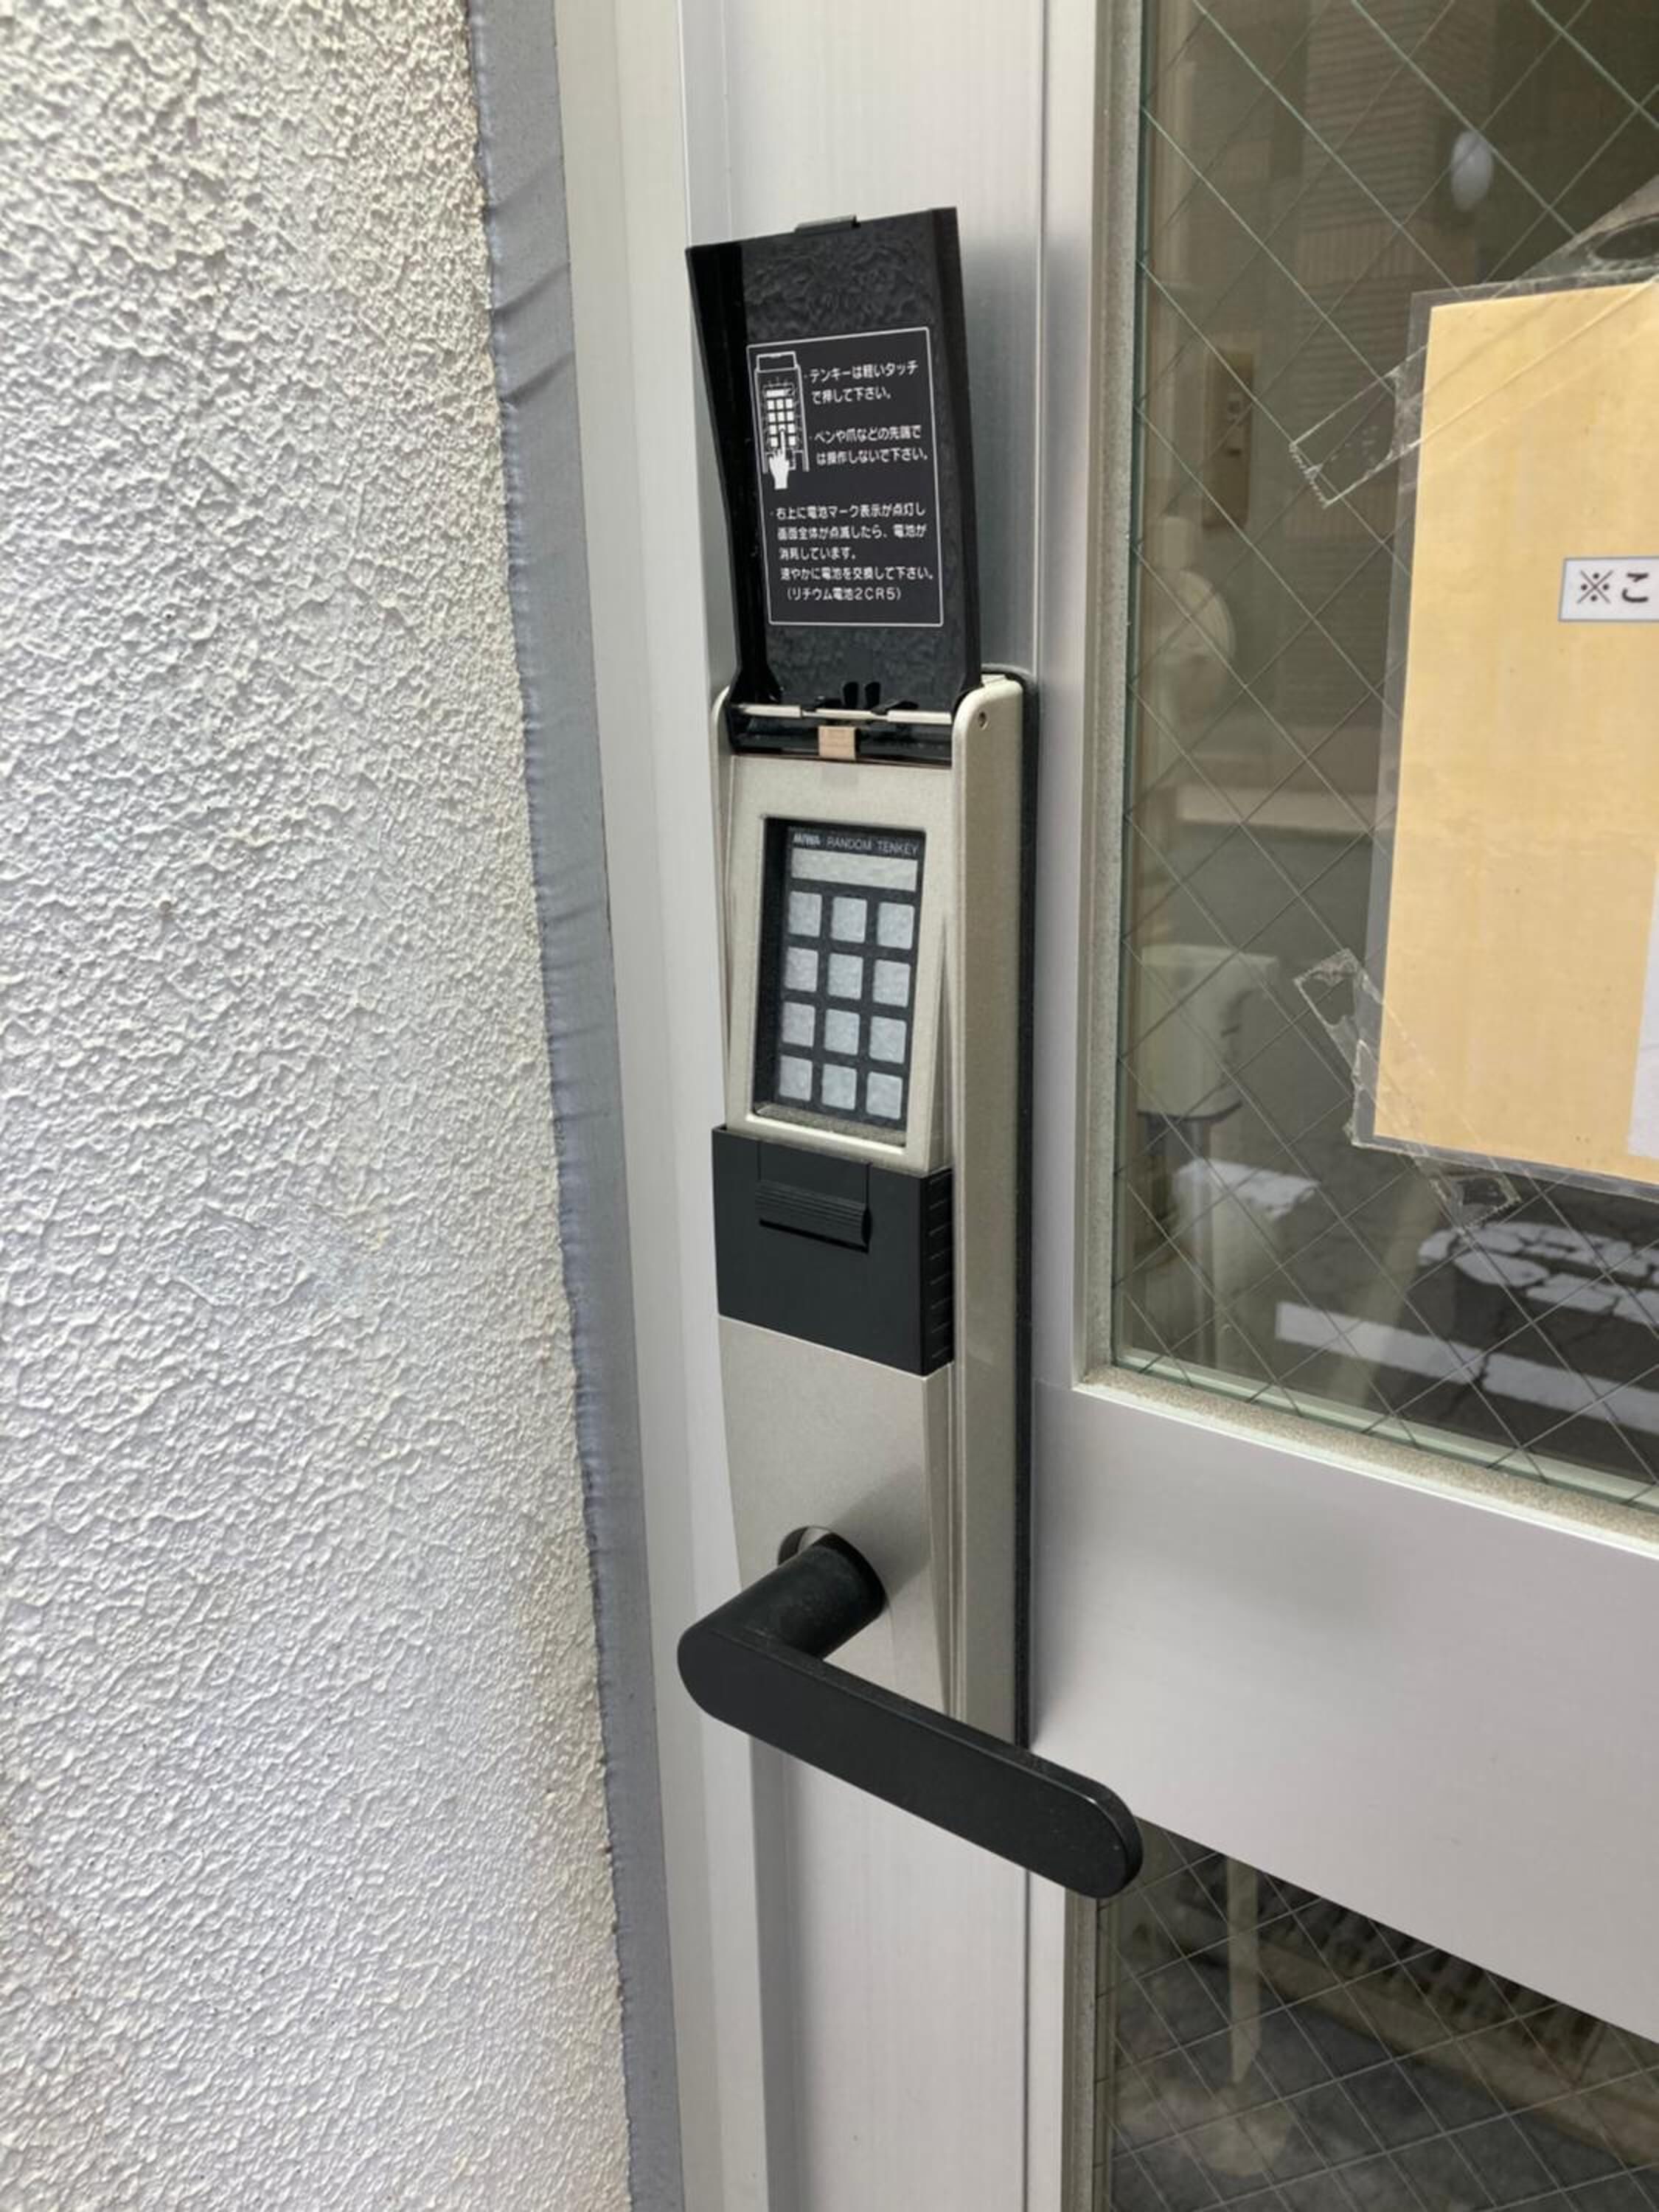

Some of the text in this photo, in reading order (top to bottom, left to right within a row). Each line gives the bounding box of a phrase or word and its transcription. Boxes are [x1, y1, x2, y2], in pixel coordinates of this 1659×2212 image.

[812, 386, 891, 405] で押して下さい。
[816, 448, 928, 465] は操作しないで下さい。
[827, 836, 872, 850] RANDOM
[877, 840, 919, 855] TENKEY
